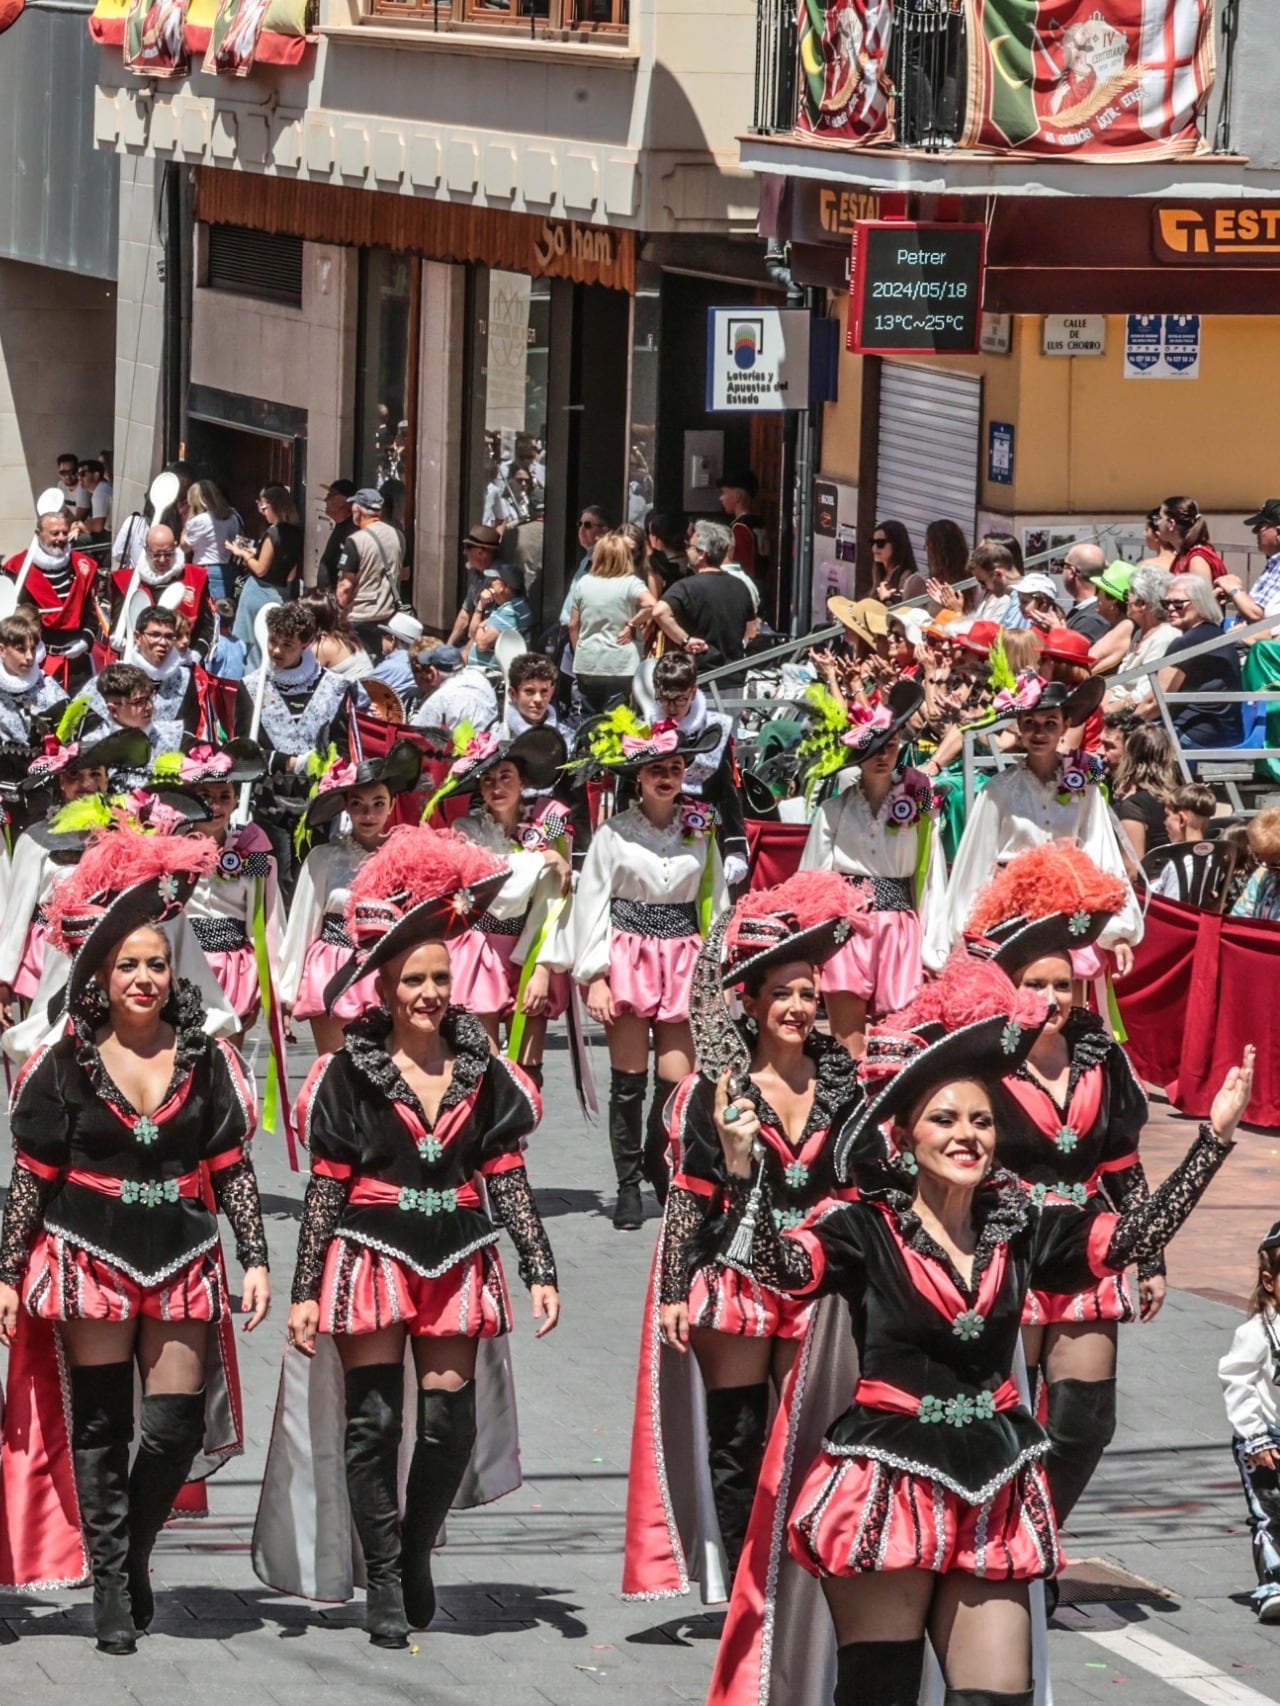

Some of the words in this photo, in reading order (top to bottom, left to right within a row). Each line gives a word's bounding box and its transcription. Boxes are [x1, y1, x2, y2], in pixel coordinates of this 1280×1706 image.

[534, 217, 567, 267] So
[571, 220, 612, 266] ham
[897, 249, 947, 265] Petrer
[872, 281, 968, 300] 2024/05/18
[1063, 319, 1087, 328] CALLE
[1069, 330, 1079, 339] DE
[1047, 341, 1064, 350] LUIS
[1067, 341, 1101, 350] CHORRO
[726, 370, 765, 381] Loterías
[768, 371, 774, 382] y
[726, 382, 771, 393] Apuestas
[773, 381, 788, 391] del
[726, 393, 759, 404] Estado
